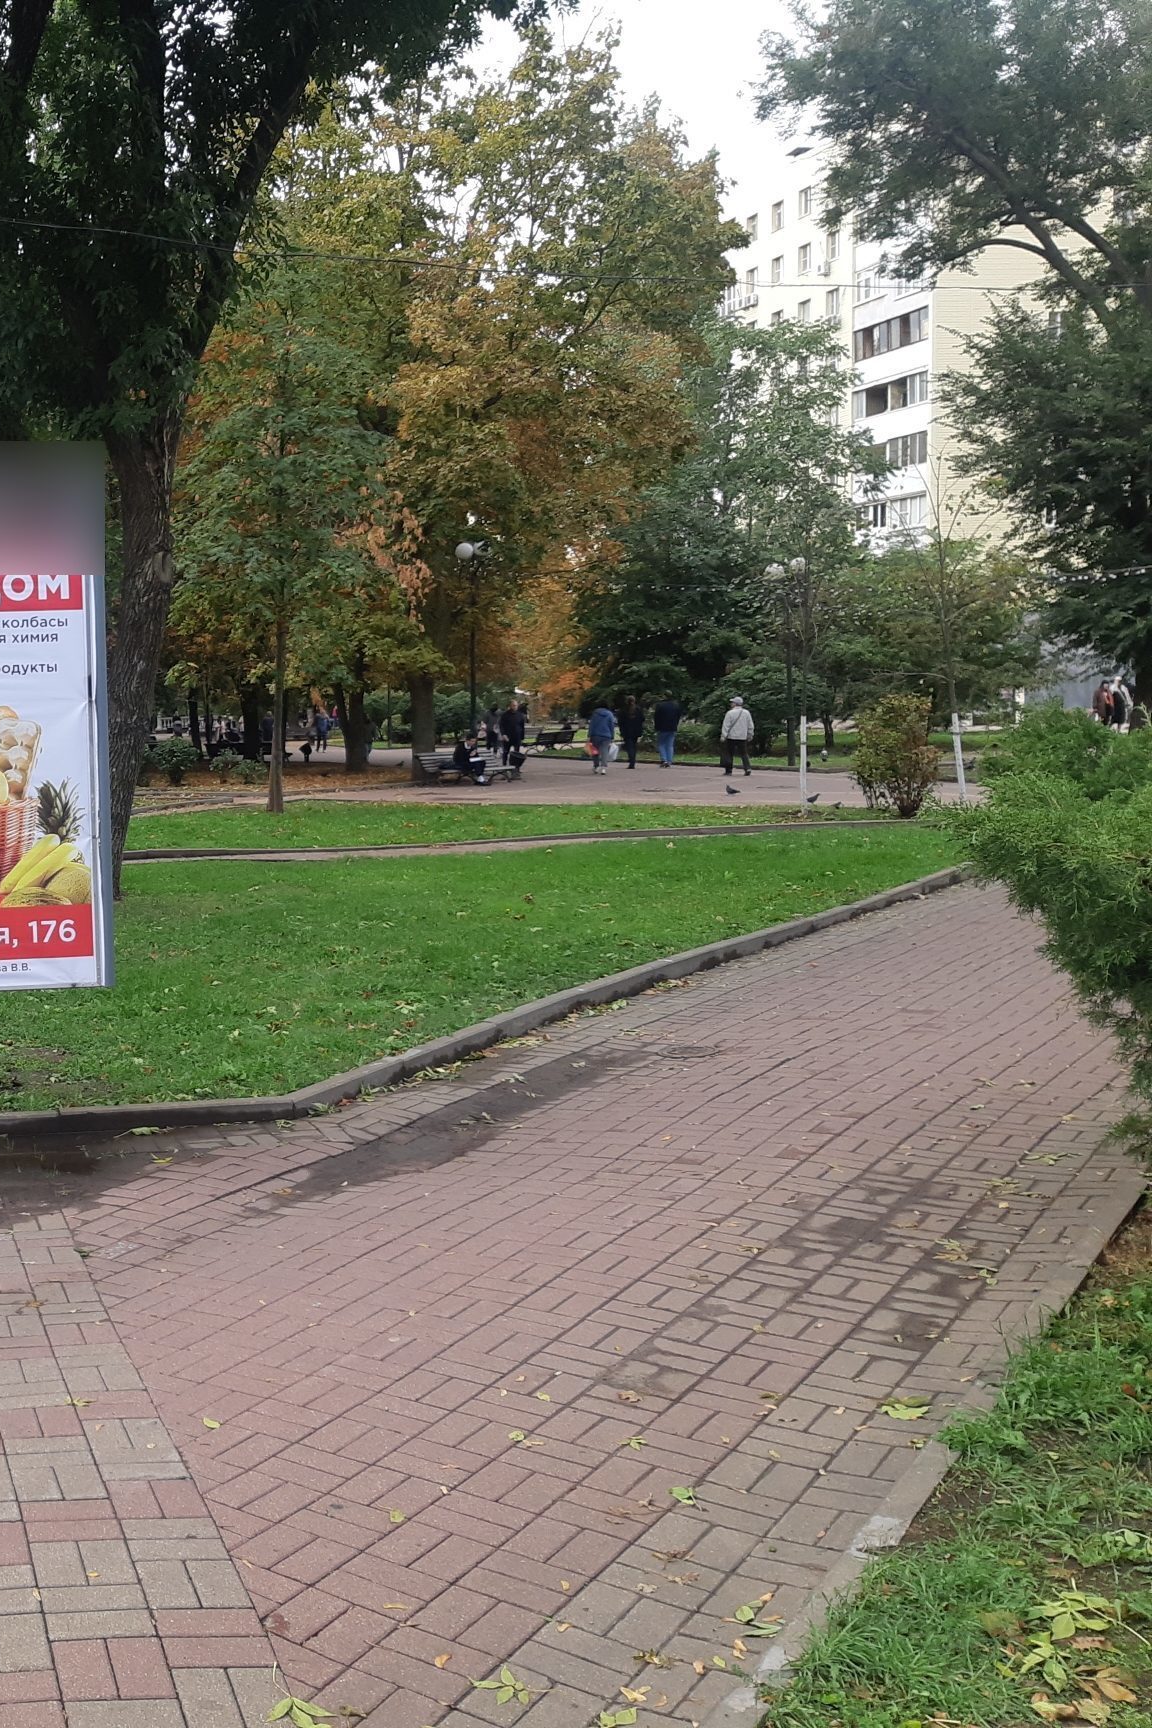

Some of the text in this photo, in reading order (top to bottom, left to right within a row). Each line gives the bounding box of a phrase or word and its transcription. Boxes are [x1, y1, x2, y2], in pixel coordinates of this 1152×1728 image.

[2, 616, 68, 630] колбасы
[12, 632, 59, 644] химия
[28, 919, 77, 944] 176
[11, 962, 32, 973] В.В.
